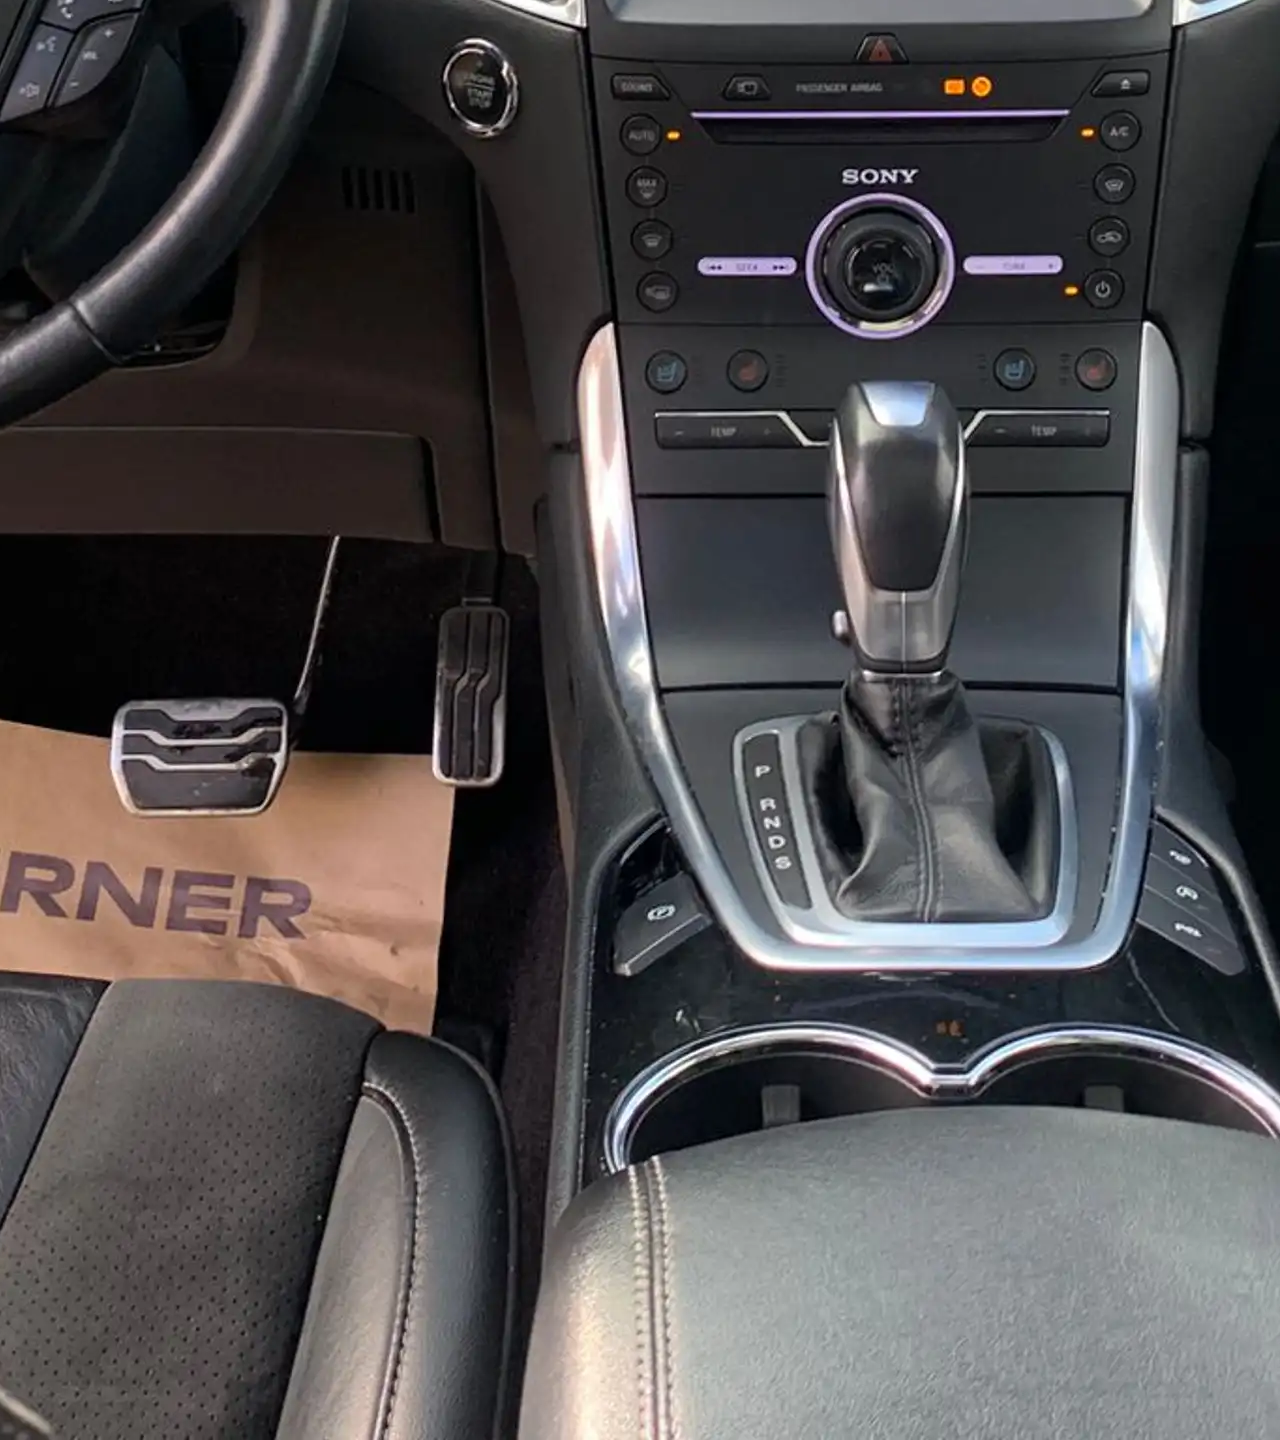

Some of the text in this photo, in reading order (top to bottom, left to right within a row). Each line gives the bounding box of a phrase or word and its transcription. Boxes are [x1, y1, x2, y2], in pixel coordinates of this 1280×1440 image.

[628, 128, 656, 142] AUTO
[841, 168, 919, 185] SONY
[754, 764, 772, 779] P
[760, 797, 777, 812] R
[763, 815, 781, 830] N
[767, 834, 787, 850] D
